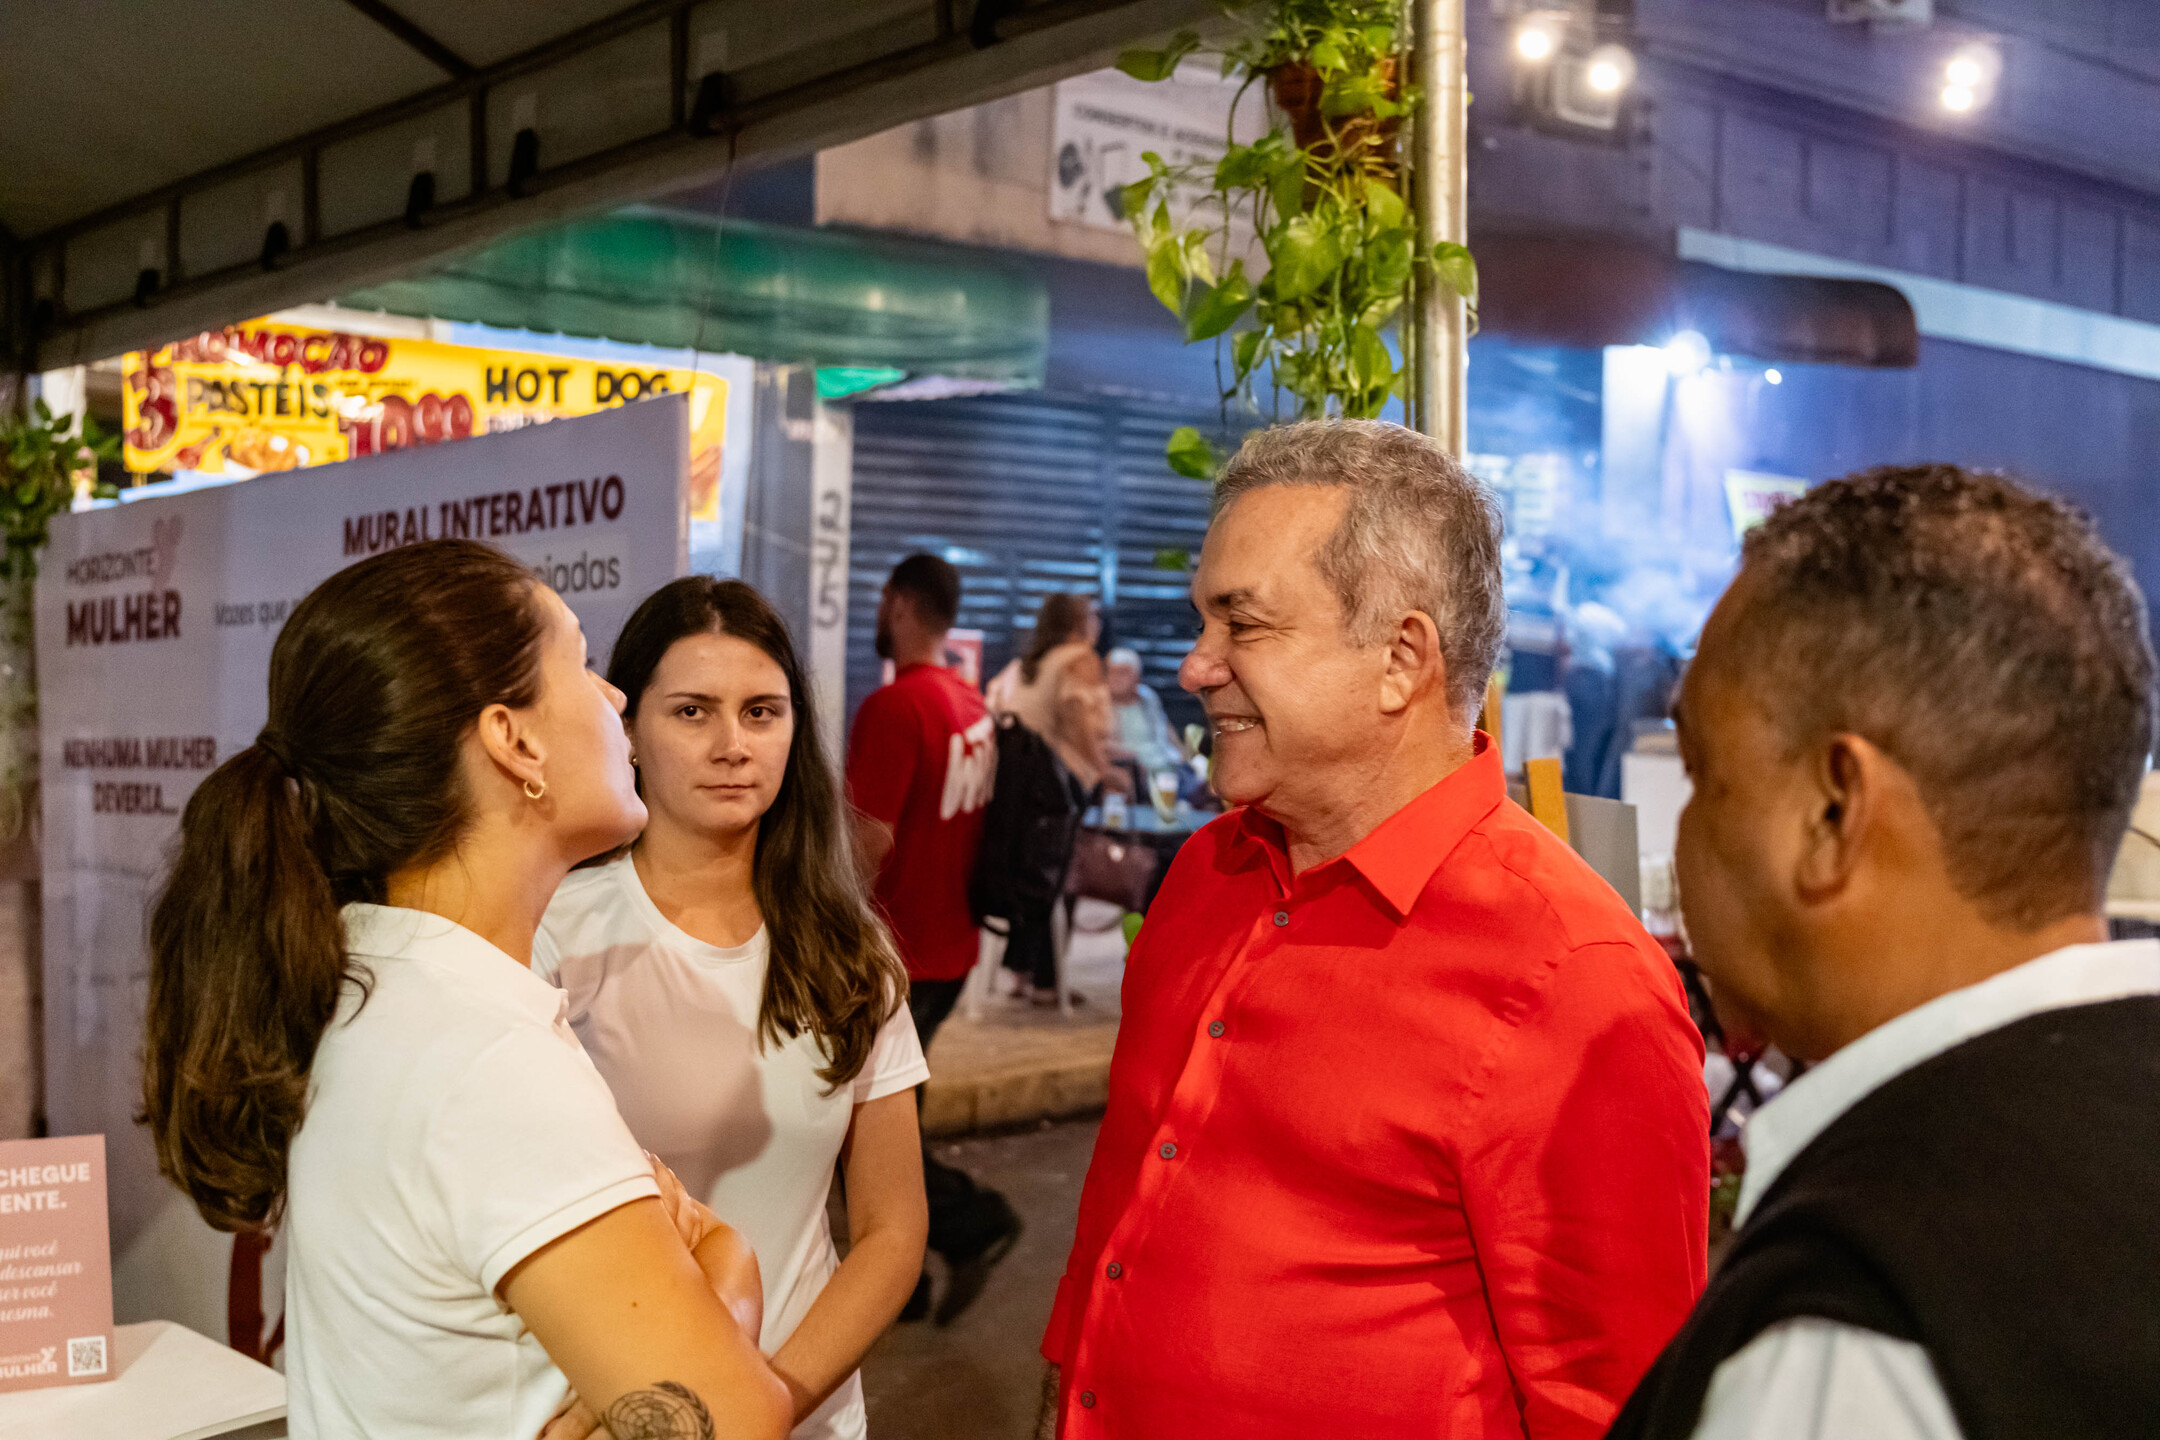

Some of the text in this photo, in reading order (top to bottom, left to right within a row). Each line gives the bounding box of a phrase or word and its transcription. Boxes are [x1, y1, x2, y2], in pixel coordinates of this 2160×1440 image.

[487, 367, 668, 403] HOT DOG
[343, 474, 626, 556] MURAL INTERATIVO
[66, 589, 183, 646] MULHER
[64, 735, 216, 769] NENHUMA MULHER
[0, 1361, 58, 1379] ULHER
